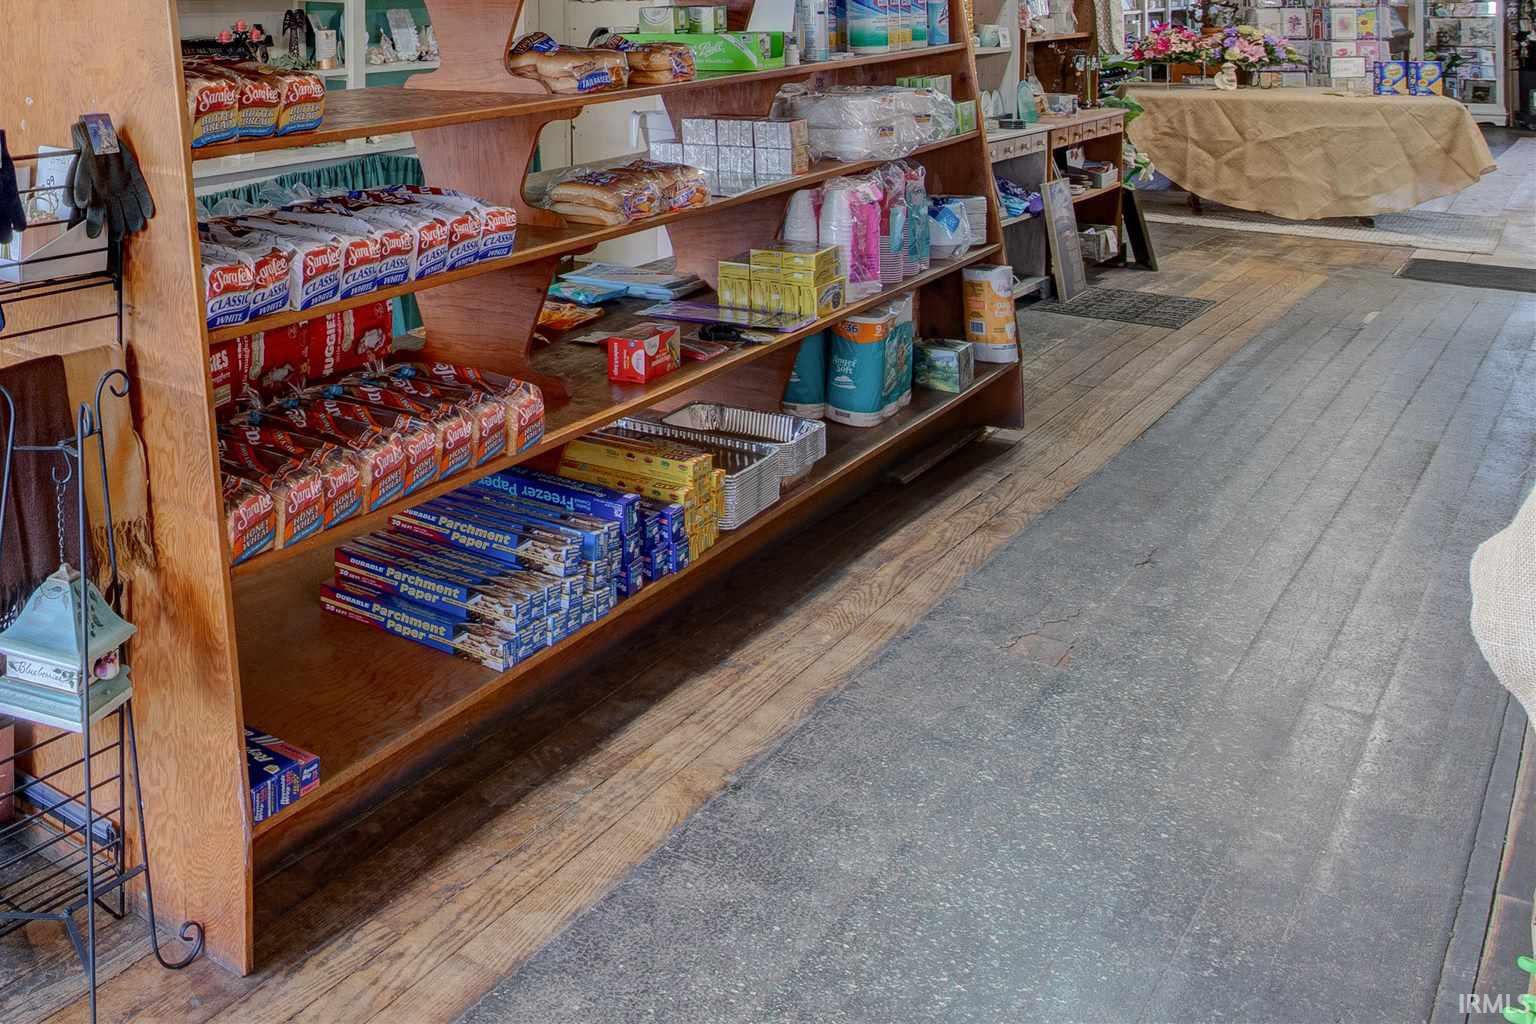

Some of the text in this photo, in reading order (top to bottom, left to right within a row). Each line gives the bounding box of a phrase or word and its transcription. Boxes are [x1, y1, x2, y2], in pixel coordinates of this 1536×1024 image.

[259, 301, 283, 315] WHITE
[216, 314, 243, 326] WHITE
[478, 475, 517, 497] Paper
[521, 485, 575, 511] Freezer
[438, 515, 512, 545] Parchment
[451, 530, 490, 551] Paper
[386, 567, 461, 599] Parchment
[400, 584, 440, 603] Paper
[336, 592, 446, 637] DURABLE Parchment
[386, 619, 426, 640] Paper
